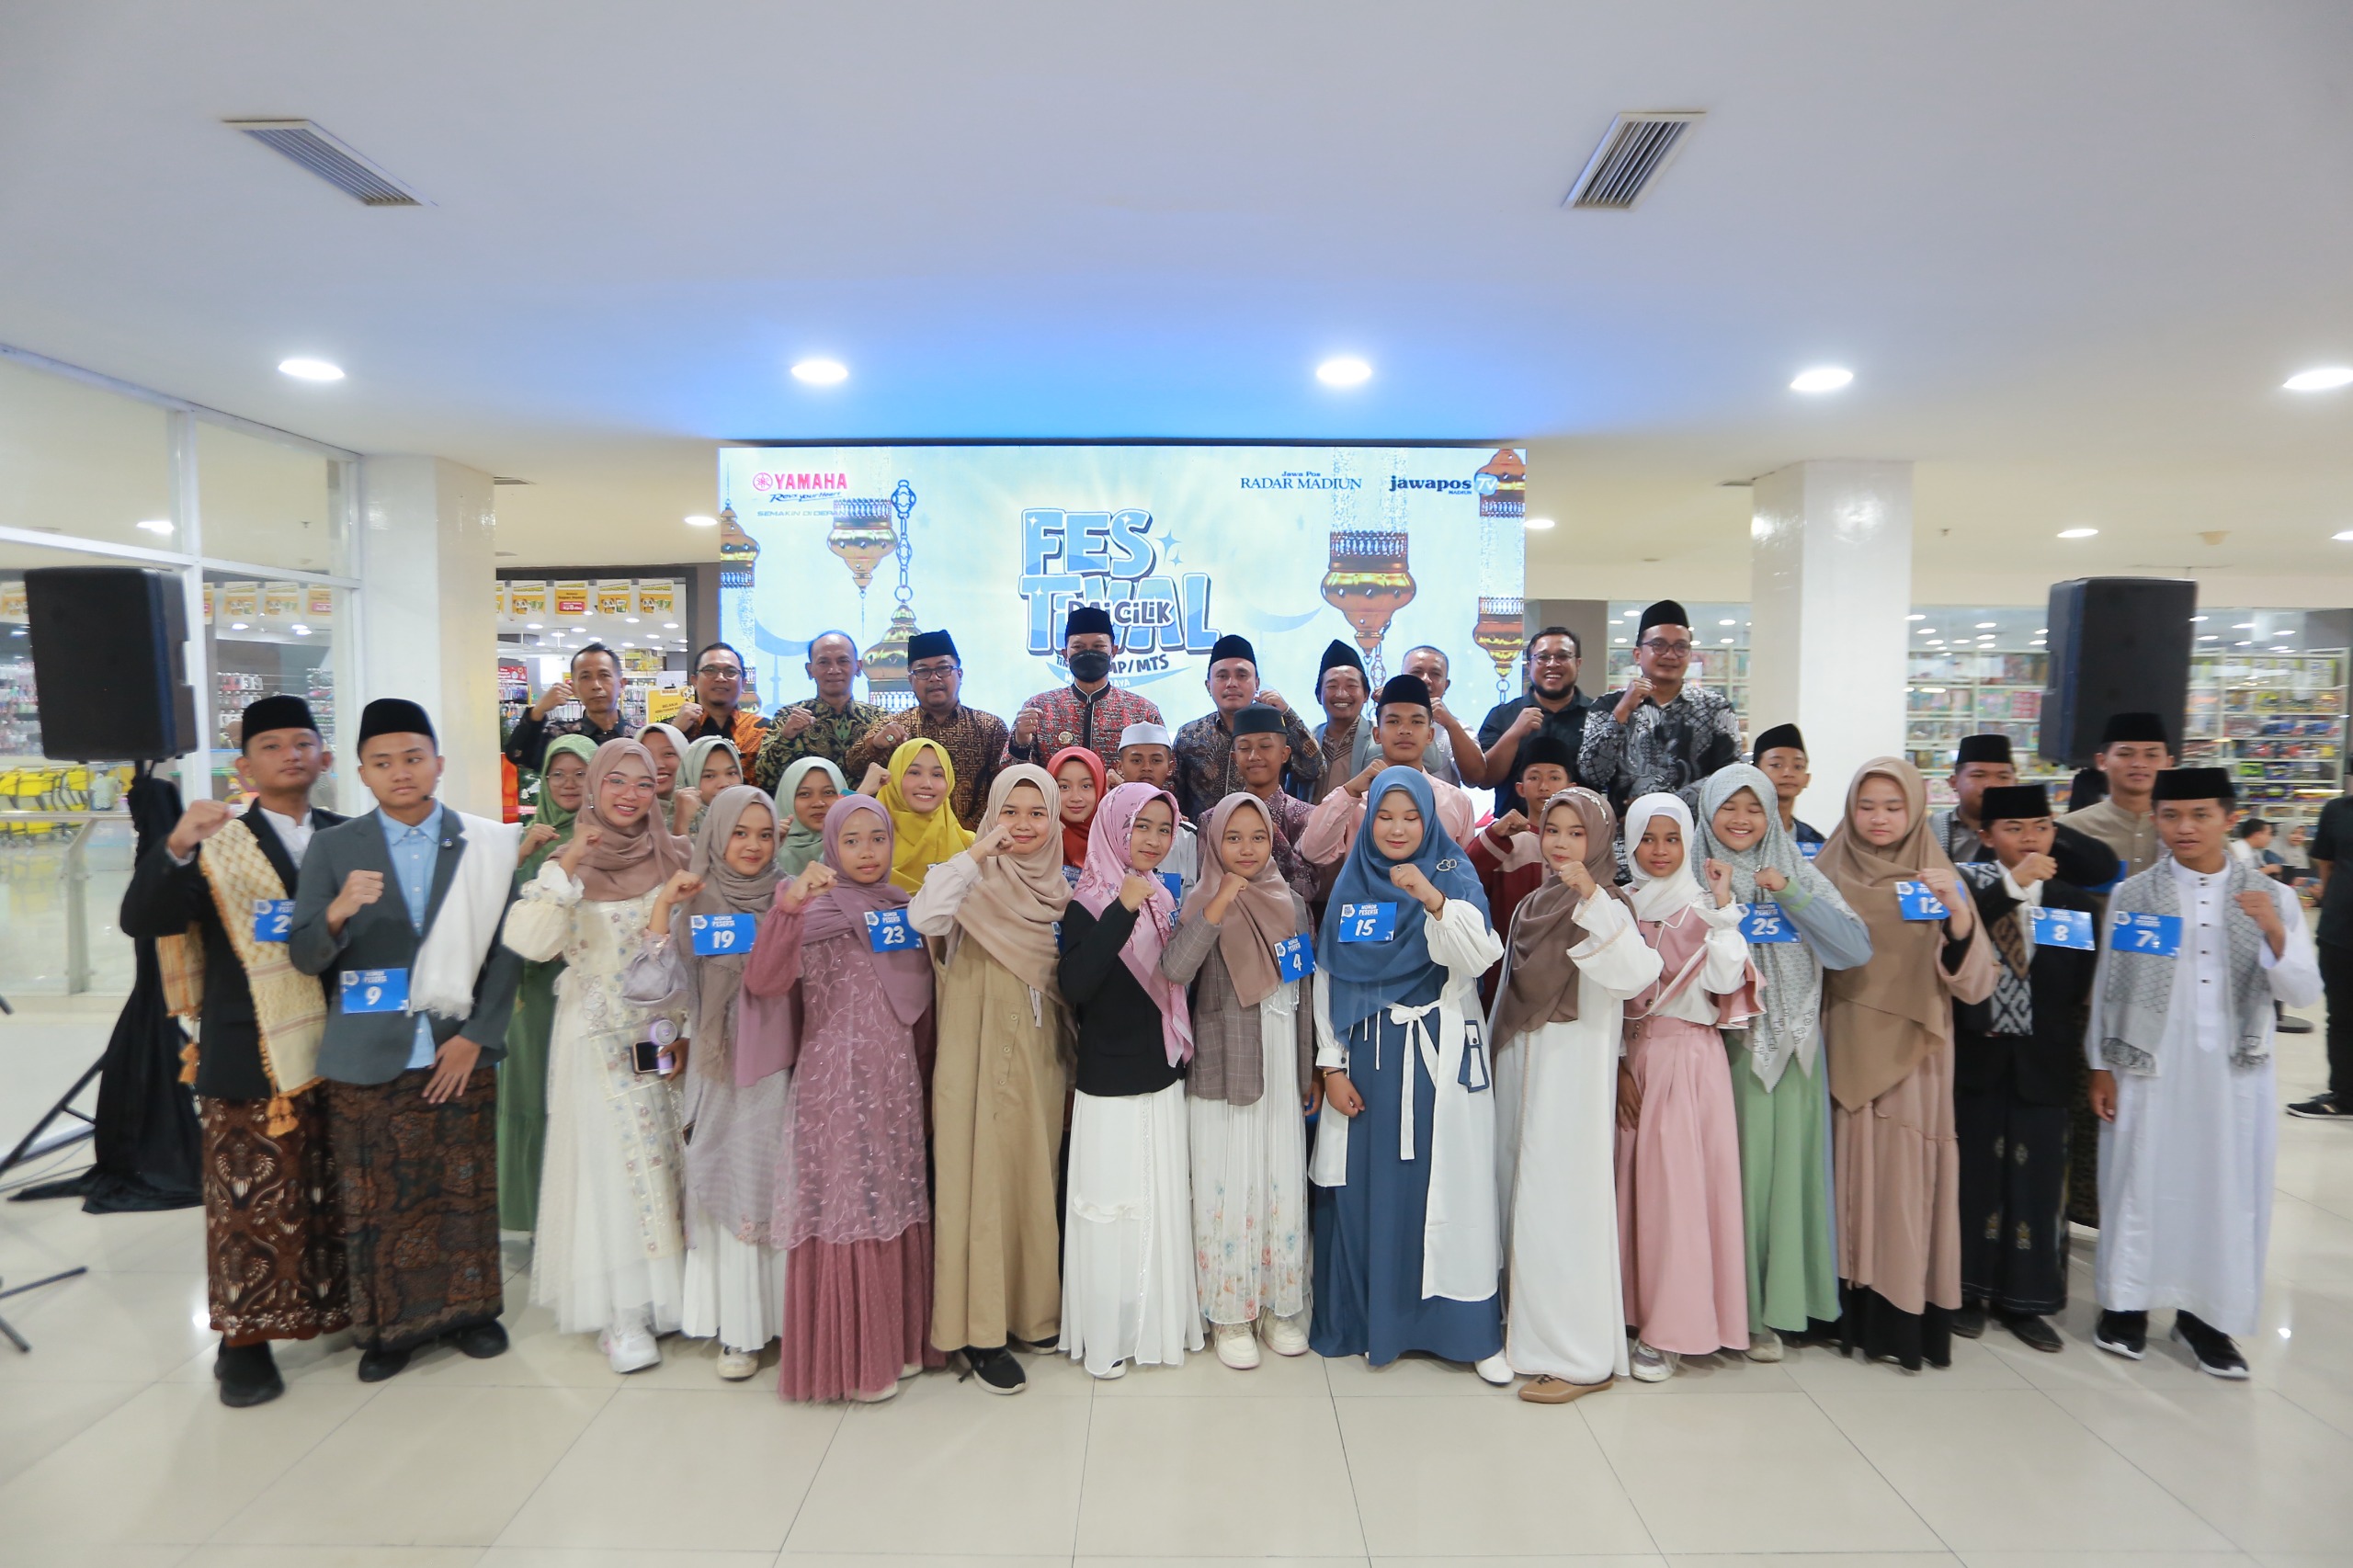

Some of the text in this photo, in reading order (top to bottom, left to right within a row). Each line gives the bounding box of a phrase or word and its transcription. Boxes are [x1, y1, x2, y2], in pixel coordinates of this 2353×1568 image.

[775, 473, 847, 490] YAMAHA
[1240, 478, 1361, 490] RADAR MADIUN
[1389, 475, 1497, 492] jawapos TV
[1022, 508, 1156, 581] FES
[1108, 654, 1170, 674] MP/MTS
[1920, 897, 1944, 914] 12
[882, 925, 905, 945] 23
[1355, 918, 1377, 937] 15
[1751, 917, 1781, 936] 25
[2054, 925, 2069, 941] 8
[713, 930, 735, 949] 19
[2136, 929, 2154, 947] 7
[1293, 953, 1302, 971] 4
[367, 986, 382, 1006] 9
